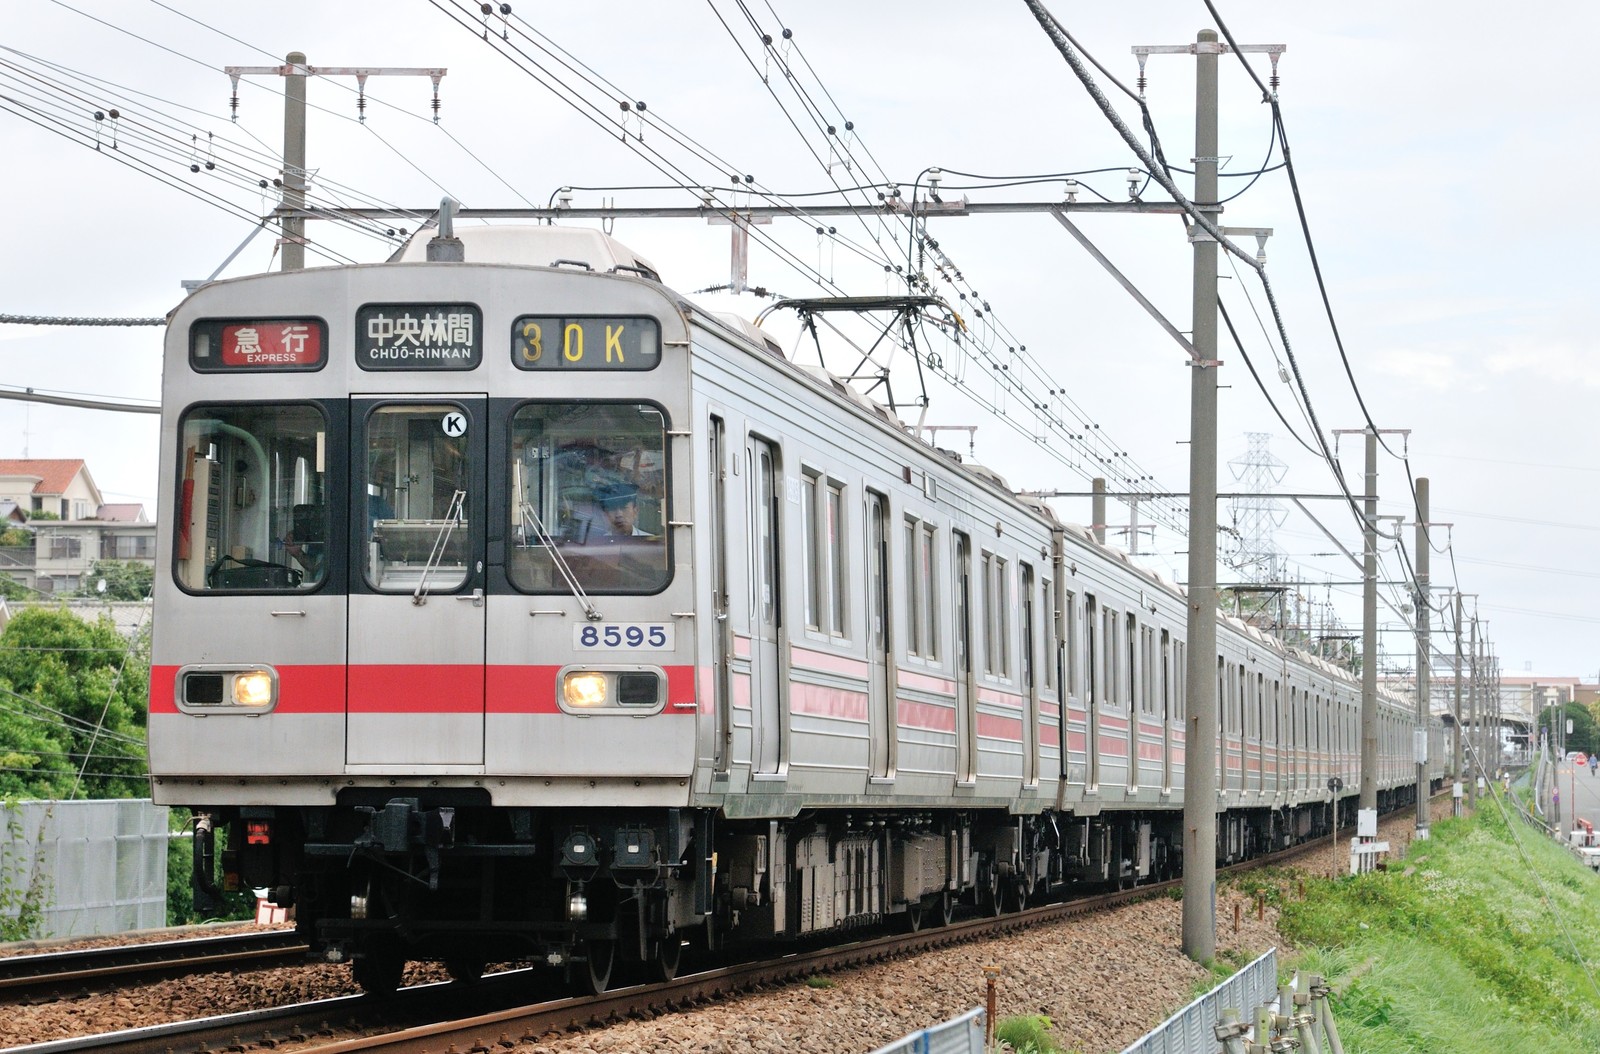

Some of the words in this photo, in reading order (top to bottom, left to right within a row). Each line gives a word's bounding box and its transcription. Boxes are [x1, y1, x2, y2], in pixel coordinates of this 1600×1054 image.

[368, 313, 473, 347] 中央林間
[247, 353, 297, 363] EXPRESS
[447, 416, 462, 433] K
[580, 625, 667, 648] 8595
